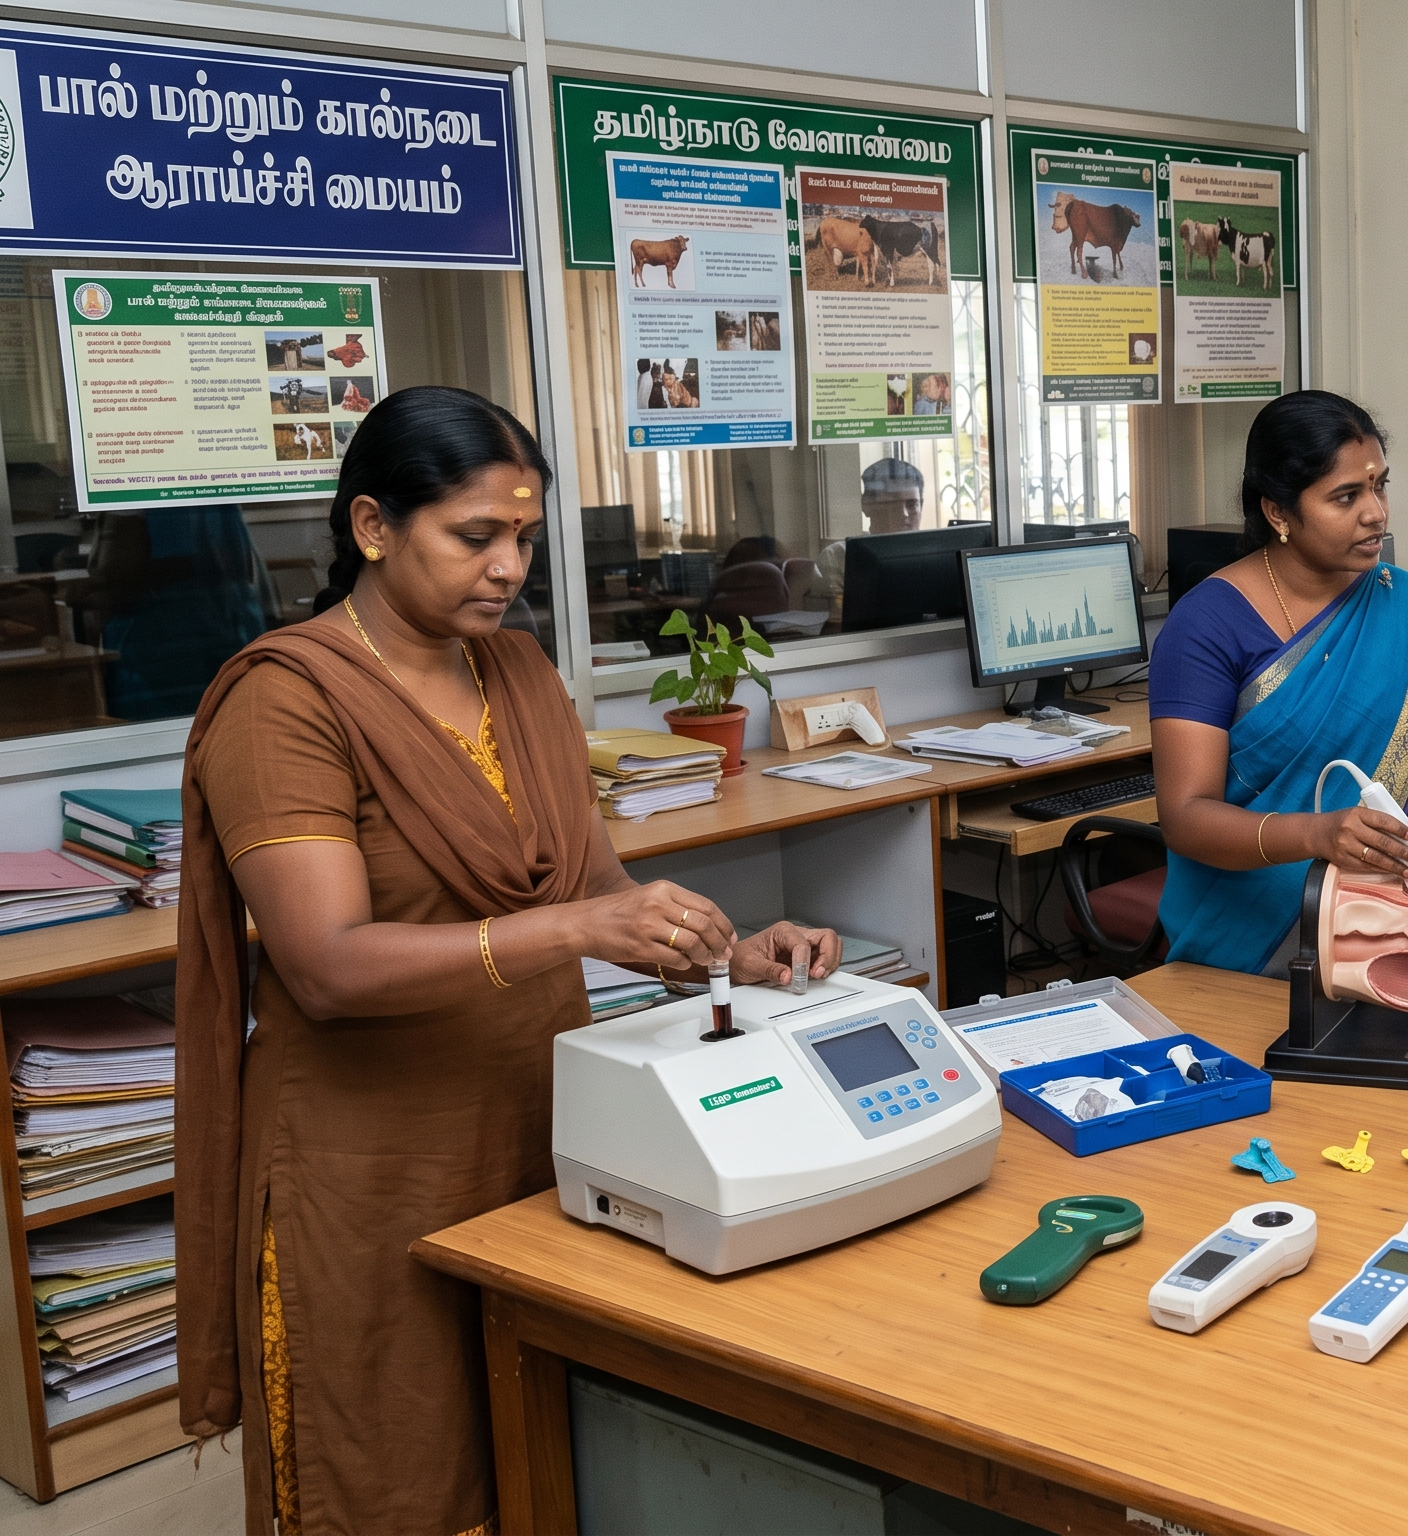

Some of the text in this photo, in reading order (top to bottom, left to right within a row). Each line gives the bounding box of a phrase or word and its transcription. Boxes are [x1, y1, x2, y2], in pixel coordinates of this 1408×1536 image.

[38, 62, 497, 153] பால் மற்றும் கால்நடை
[593, 103, 952, 164] தமிழ்நாடு வேளாண்மை
[105, 150, 463, 215] ஆராய்ச்சி மையம்
